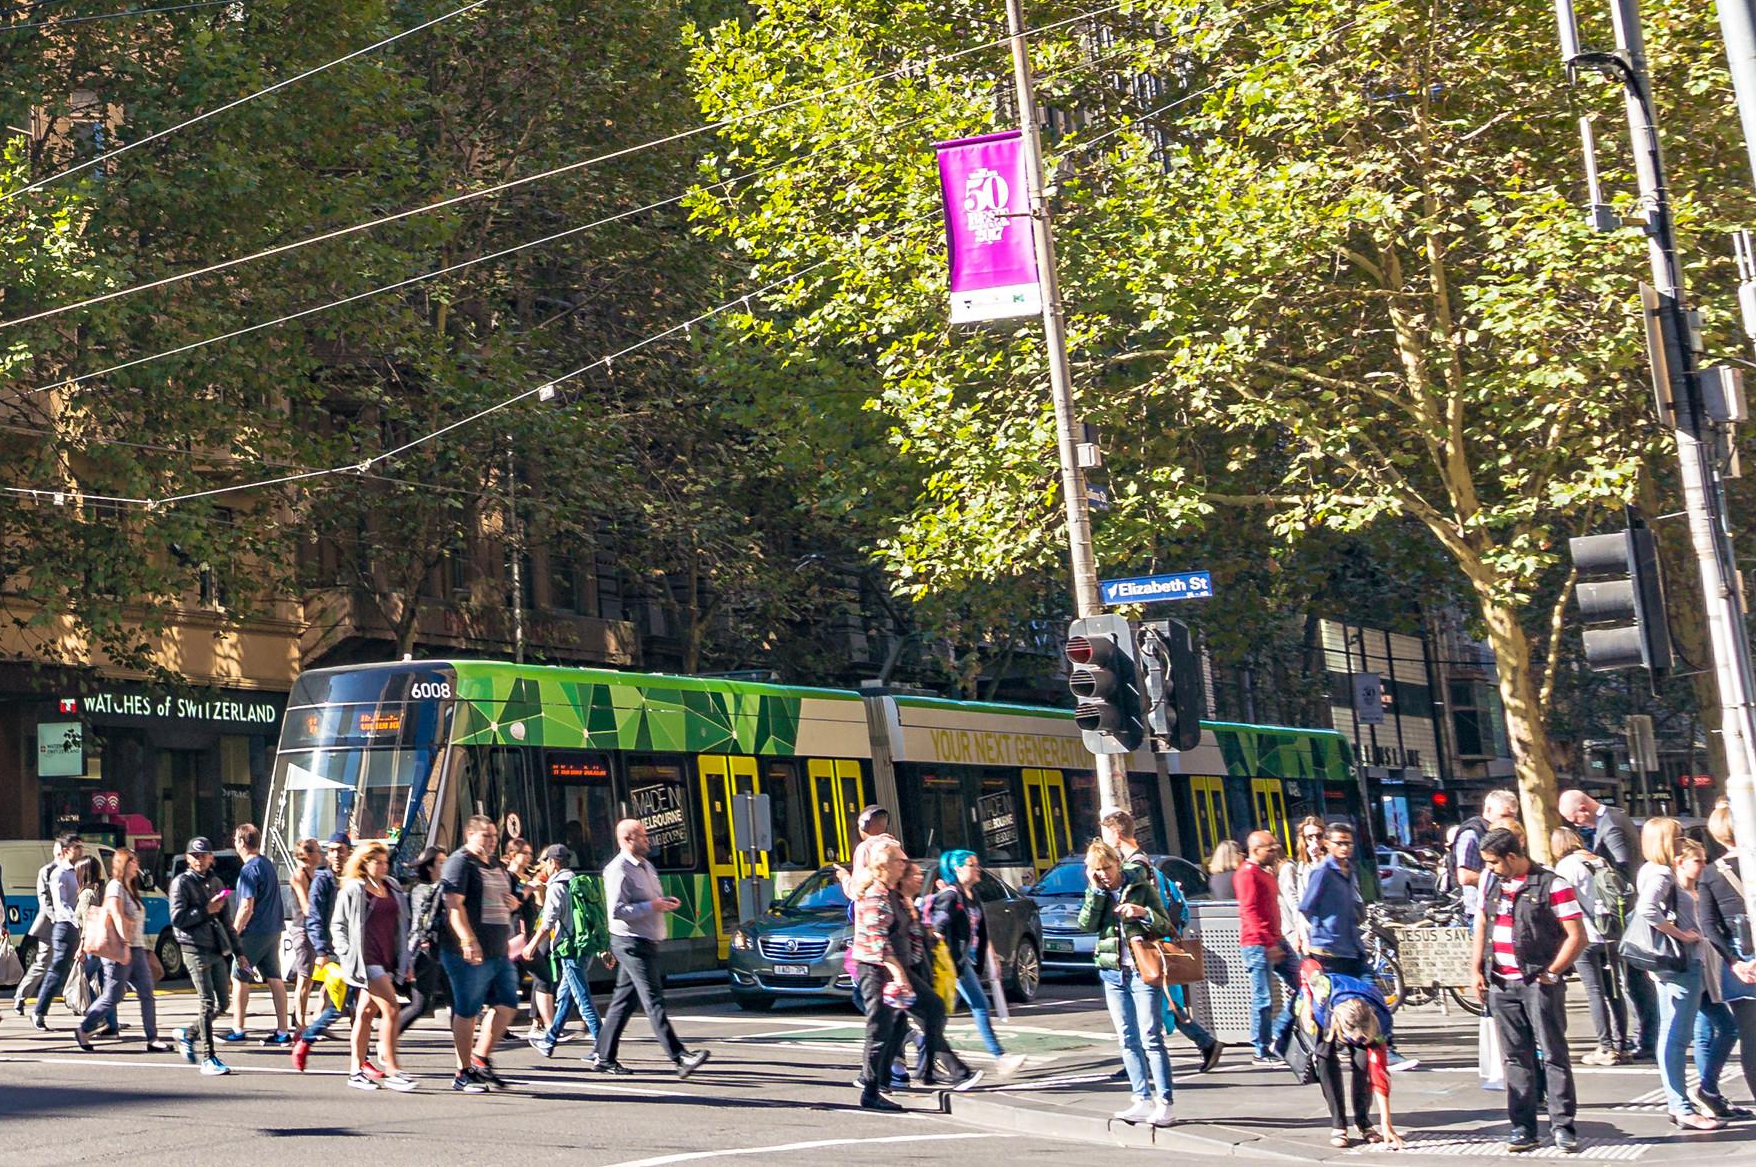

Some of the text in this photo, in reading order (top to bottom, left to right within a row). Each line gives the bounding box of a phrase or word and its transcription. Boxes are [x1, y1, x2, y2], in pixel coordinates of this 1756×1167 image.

[964, 175, 1008, 212] 50
[1119, 578, 1187, 596] Elizabeth
[1189, 576, 1208, 590] St
[411, 683, 451, 699] 6008
[83, 693, 276, 723] WATCHES of SWITZERLAND
[930, 730, 971, 763] YOUR
[974, 732, 1011, 764] NEXT
[632, 788, 669, 815] MADE
[1397, 929, 1438, 942] JESUS
